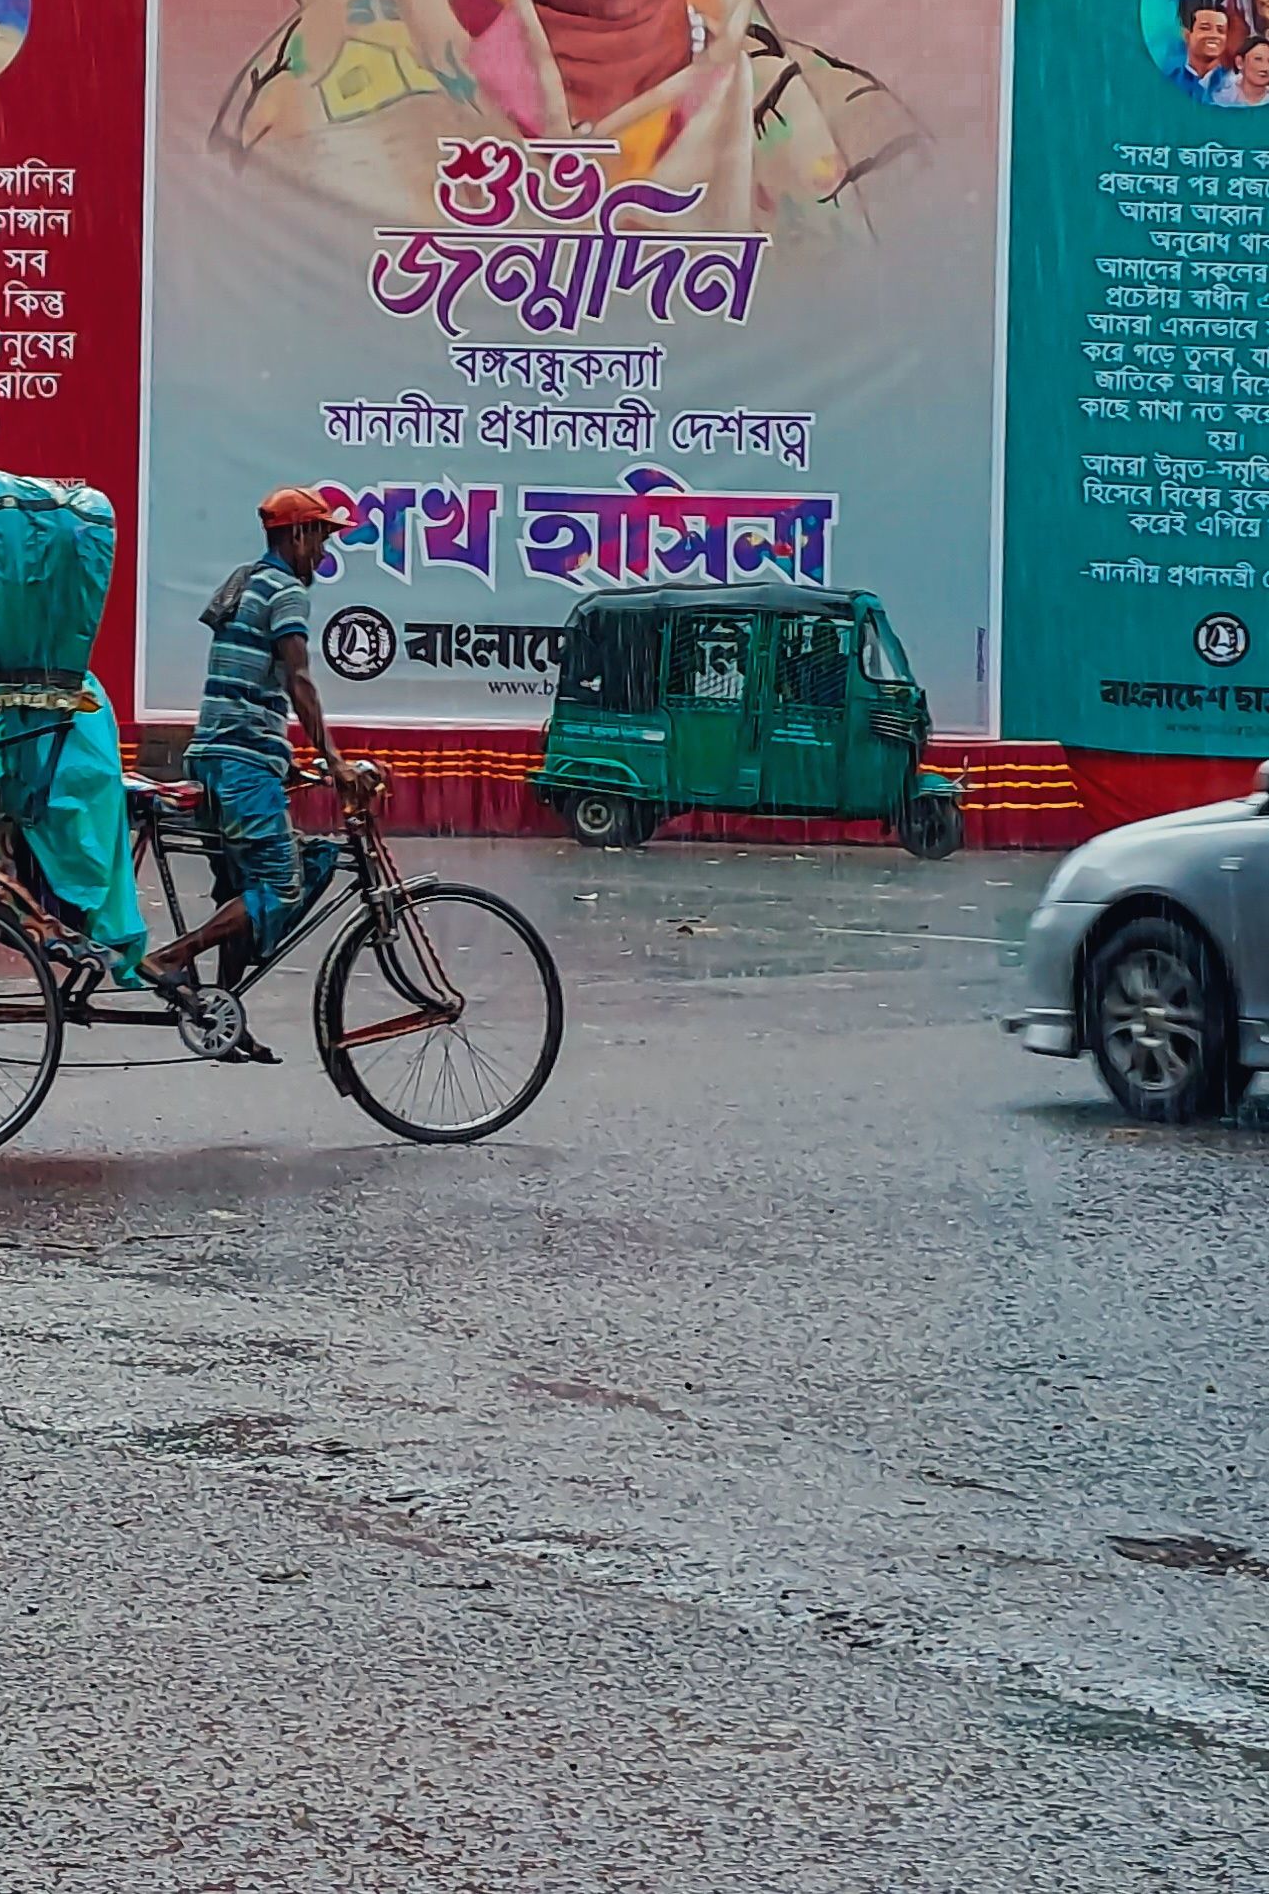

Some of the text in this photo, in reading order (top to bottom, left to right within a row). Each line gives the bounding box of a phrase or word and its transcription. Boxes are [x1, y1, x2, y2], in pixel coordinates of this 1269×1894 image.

[1177, 141, 1244, 169] জাতির
[1250, 149, 1269, 170] ক
[436, 136, 620, 230] শুভ
[1098, 172, 1181, 196] প্রজন্মের
[1187, 175, 1220, 197] পর
[1118, 201, 1264, 227] আমার আহ্বান
[1149, 231, 1232, 258] অনুরোধ
[3, 249, 50, 277] সব
[369, 180, 773, 339] জন্মদিন
[1095, 258, 1269, 284] আমাদের সকলের
[3, 279, 66, 319] কিন্তু
[1105, 281, 1182, 309] প্রচেষ্টায়
[1188, 283, 1250, 312] স্বাধীন
[1086, 313, 1258, 340] আমরা এমনভাবে
[452, 344, 664, 396] বঙ্গবন্ধুকন্যা
[1081, 341, 1125, 363] করে
[1133, 343, 1177, 370] গড়ে
[1094, 364, 1175, 392] জাতিকে
[1182, 373, 1224, 395] আর
[1078, 397, 1131, 421] কাছে
[1137, 399, 1184, 422] মাথা
[1188, 402, 1227, 423] নত
[323, 391, 812, 468] মাননীয় প্রধানমন্ত্রী দেশরত্ন
[1206, 430, 1245, 453] হয়।
[1081, 454, 1148, 478] আমরা
[1083, 475, 1153, 506] হিসেবে
[1160, 480, 1222, 509] বিশ্বের
[520, 464, 836, 590] হাসিনা
[1127, 507, 1262, 538] করেই এগিয়ে
[1167, 561, 1257, 589] প্রধানমন্ত্রী
[404, 623, 564, 673] বাংলাদে
[488, 679, 554, 696] www.b
[1099, 678, 1229, 712] বাংলাদেশ
